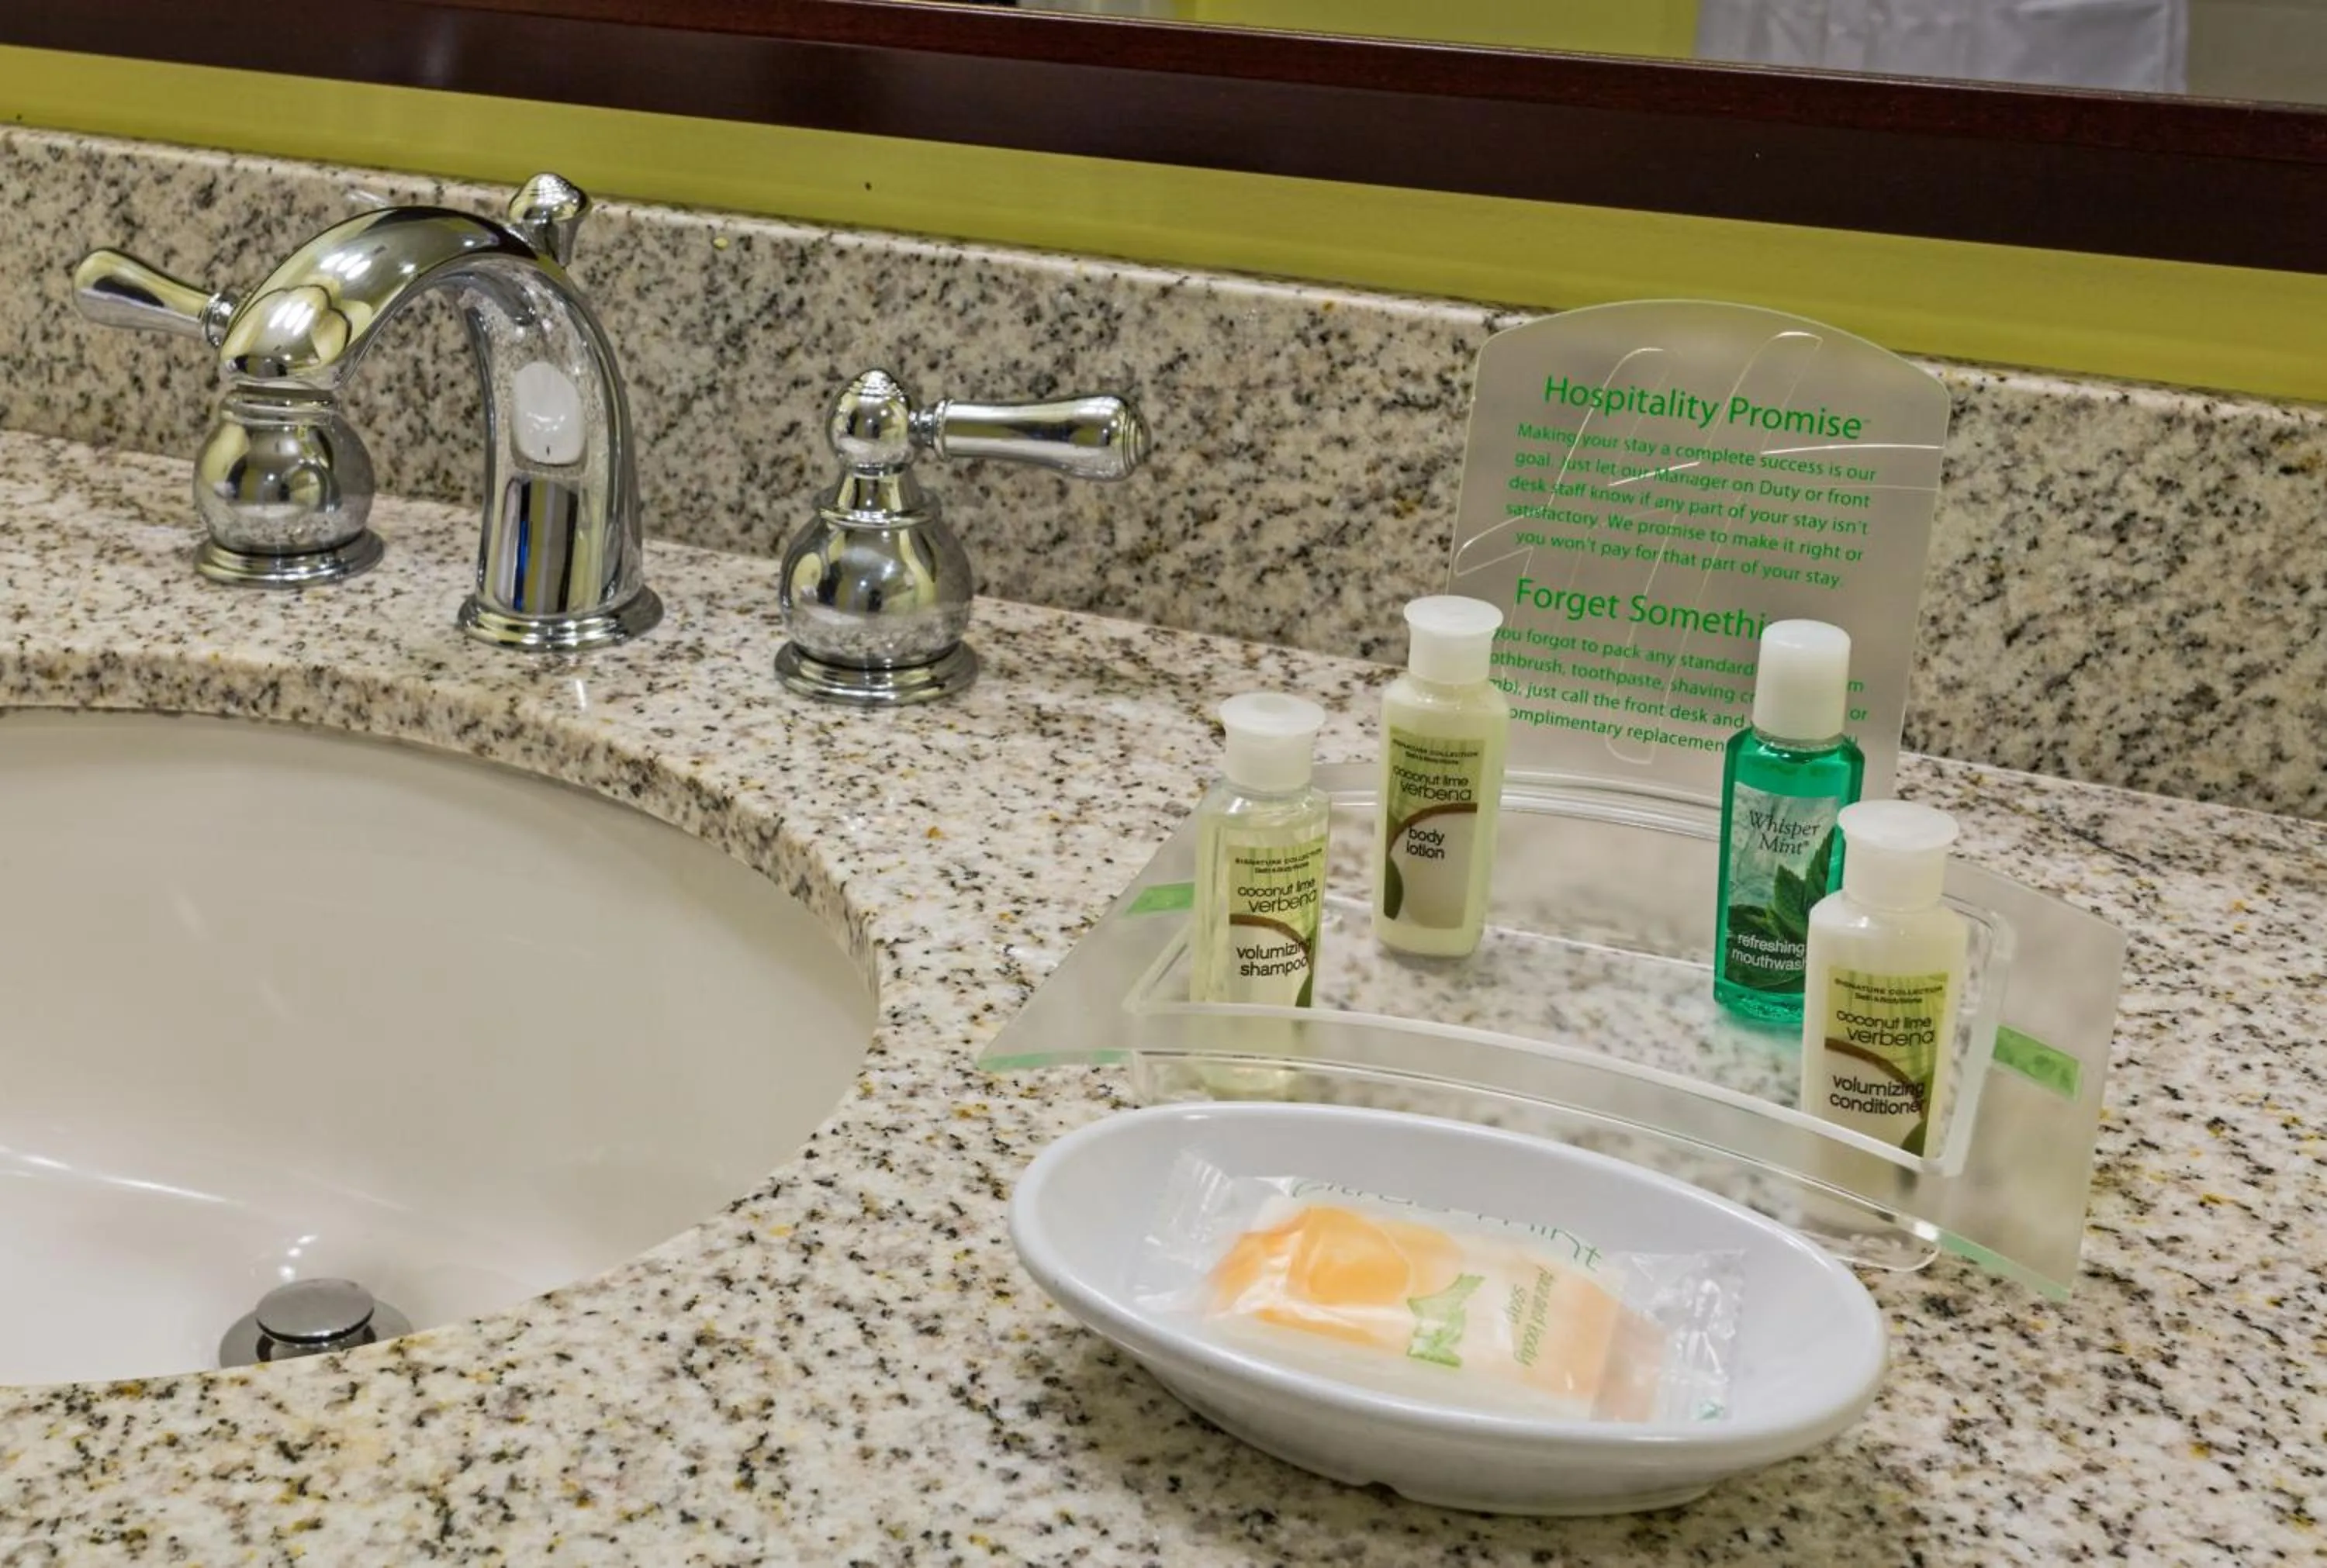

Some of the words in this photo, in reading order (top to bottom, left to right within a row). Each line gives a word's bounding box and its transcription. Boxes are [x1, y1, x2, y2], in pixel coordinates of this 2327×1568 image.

[1544, 375, 1720, 429] Hospitality
[1728, 396, 1862, 440] Promise
[1517, 422, 1576, 447] Making
[1582, 433, 1619, 449] your
[1624, 438, 1657, 456] stay
[1660, 444, 1671, 455] a
[1675, 445, 1756, 467] complete
[1760, 456, 1824, 475] success
[1829, 463, 1841, 478] is
[1846, 467, 1876, 481] our
[1596, 458, 1616, 476] let
[1620, 465, 1650, 480] our
[1654, 467, 1728, 491] Manager
[1732, 479, 1754, 493] on
[1759, 479, 1800, 502] Duty
[1805, 488, 1824, 502] or
[1827, 488, 1871, 508] front
[1508, 475, 1546, 492] desk
[1551, 482, 1587, 498] staff
[1590, 484, 1634, 504] know
[1639, 491, 1652, 506] if
[1654, 497, 1686, 513] any
[1688, 500, 1724, 517] part
[1727, 503, 1748, 519] of
[1749, 509, 1789, 524] your
[1793, 513, 1827, 532] stay
[1832, 517, 1869, 535] isn't
[1607, 513, 1634, 530] We
[1637, 520, 1706, 541] promise
[1710, 530, 1727, 544] to
[1732, 534, 1779, 551] make
[1783, 537, 1794, 553] it
[1799, 541, 1841, 561] right
[1845, 548, 1864, 562] or
[1515, 531, 1545, 545] you
[1551, 535, 1597, 554] won't
[1599, 544, 1632, 560] pay
[1635, 544, 1658, 561] for
[1662, 549, 1696, 567] that
[1699, 556, 1736, 572] part
[1740, 558, 1759, 574] of
[1762, 565, 1801, 580] your
[1516, 577, 1620, 621] Forget
[1627, 594, 1768, 641] Somethi
[1526, 628, 1577, 650] forgot
[1581, 638, 1599, 653] to
[1603, 644, 1641, 659] pack
[1645, 648, 1675, 667] any
[1680, 654, 1755, 677] standard
[1489, 651, 1566, 675] othbrush,
[1670, 677, 1736, 704] shaving
[1526, 682, 1557, 699] just
[1561, 689, 1589, 705] call
[1593, 693, 1620, 710] the
[1623, 696, 1665, 717] front
[1669, 704, 1708, 724] desk
[1712, 713, 1745, 729] and
[1509, 707, 1623, 739] omplimentary
[1627, 727, 1724, 752] replacemen
[1392, 765, 1440, 786] coconut
[1443, 775, 1469, 787] lime
[1400, 779, 1472, 802] verbena
[1408, 824, 1445, 847] body
[1748, 808, 1820, 838] Whisper
[1406, 840, 1445, 860] lotion
[1237, 882, 1295, 898] coconut
[1296, 878, 1316, 893] lime
[1248, 889, 1318, 914] verbena
[1737, 932, 1806, 958] refreshing
[1836, 1010, 1900, 1030] coconut
[1903, 1017, 1932, 1028] lime
[1845, 1027, 1936, 1048] verbena
[1832, 1074, 1925, 1097] volumizing
[1829, 1092, 1924, 1116] conditioner
